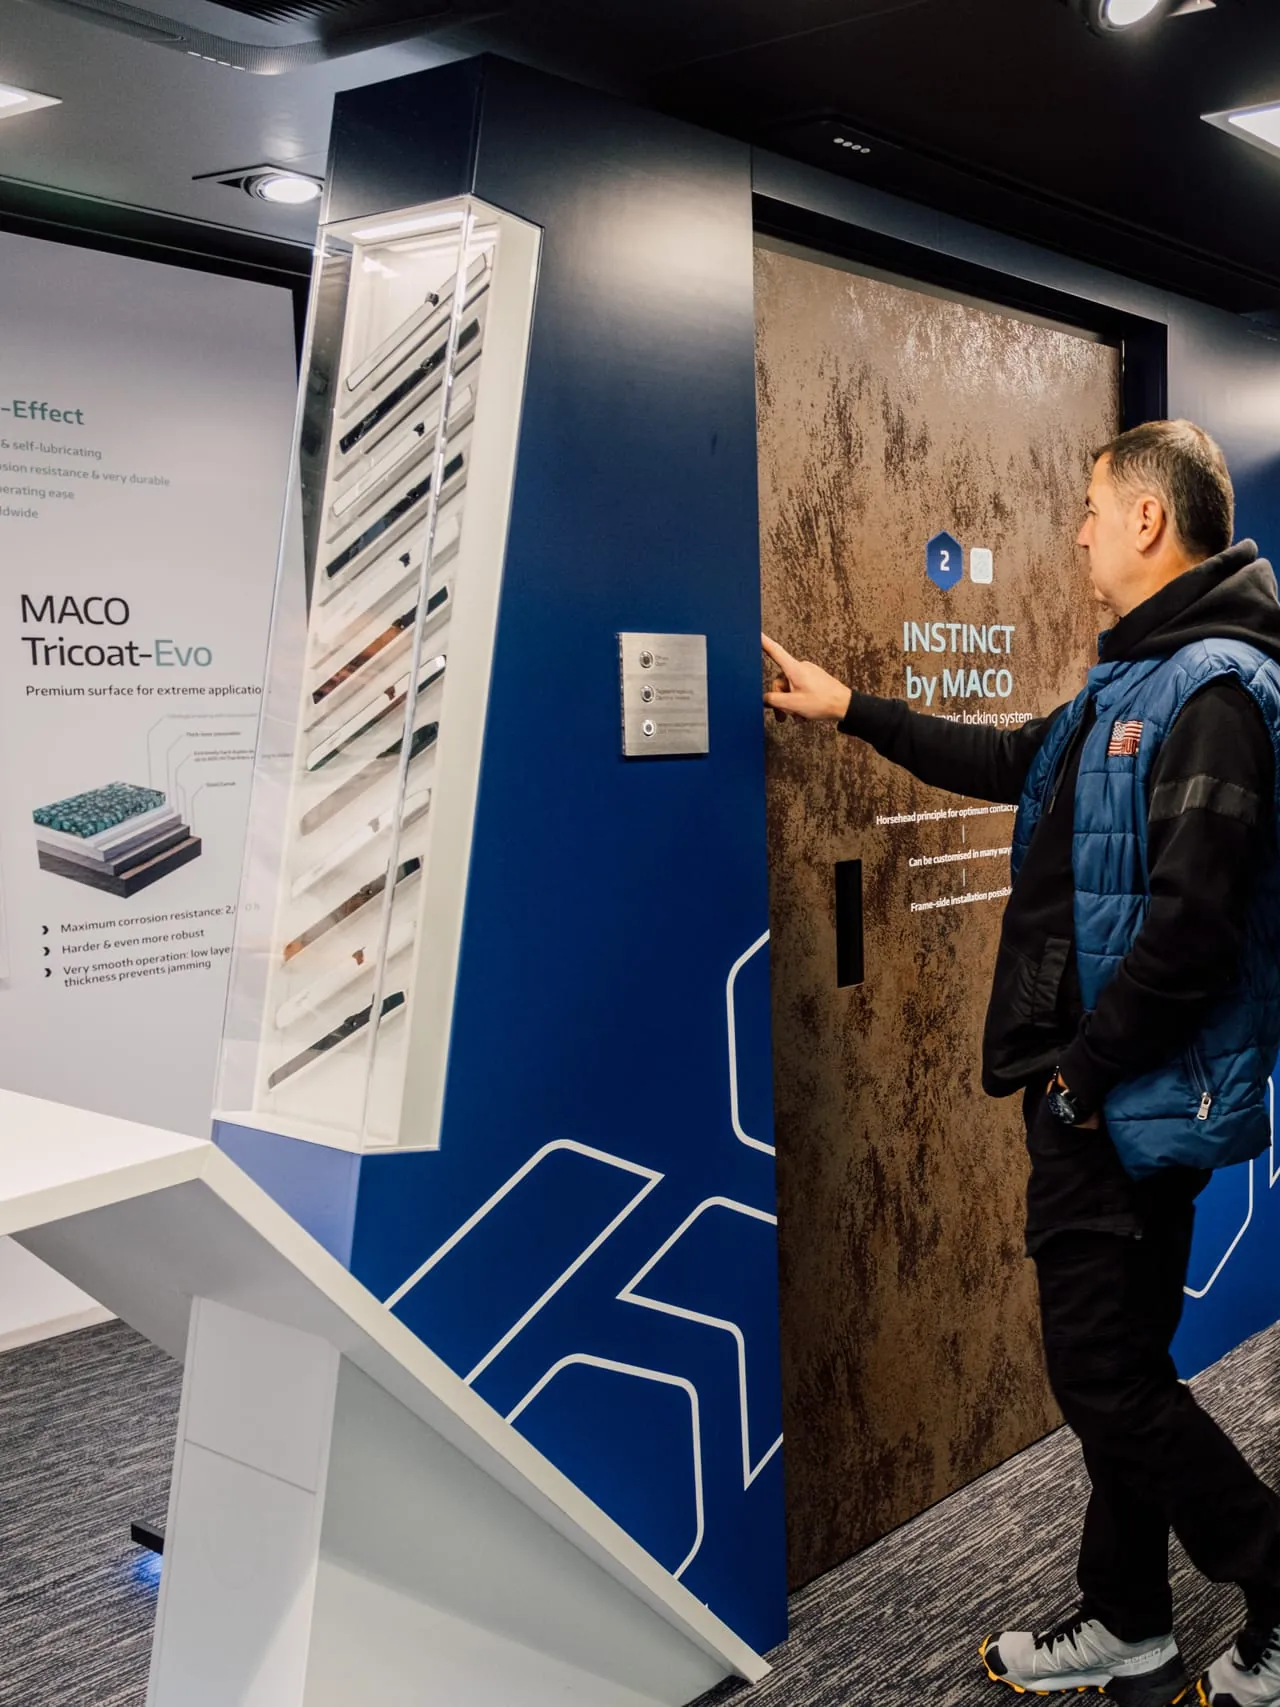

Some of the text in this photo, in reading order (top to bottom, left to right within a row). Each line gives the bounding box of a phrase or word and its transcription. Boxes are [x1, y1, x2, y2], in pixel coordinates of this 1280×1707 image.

[13, 440, 102, 460] self-lubricating
[30, 465, 89, 479] resistance
[103, 473, 127, 485] very
[129, 473, 170, 487] durable
[49, 489, 75, 500] ease
[940, 550, 950, 571] 2
[20, 594, 130, 626] MACO
[903, 621, 1015, 654] INSTINCT
[21, 636, 213, 667] Tricoat-Evo
[26, 684, 262, 697] Premium surface for extreme applicatio
[906, 666, 1013, 707] by MACO
[963, 709, 998, 727] locking
[1000, 711, 1033, 728] system
[876, 812, 916, 825] Horsehead
[917, 809, 947, 824] principle
[948, 807, 959, 819] for
[959, 805, 988, 819] optimum
[989, 804, 1013, 814] contact
[908, 857, 922, 867] Can
[923, 856, 932, 866] be
[933, 849, 972, 865] customised
[972, 849, 979, 859] in
[980, 847, 998, 859] many
[911, 896, 951, 913] Frame-side
[951, 891, 987, 906] installation
[61, 919, 116, 934] Maximum
[118, 914, 168, 928] corrosion
[170, 906, 223, 921] resistance:
[62, 929, 205, 955] Harder & even more robust
[63, 946, 233, 976] Very smooth operation: low laye
[64, 960, 211, 988] thickness prevents jamming
